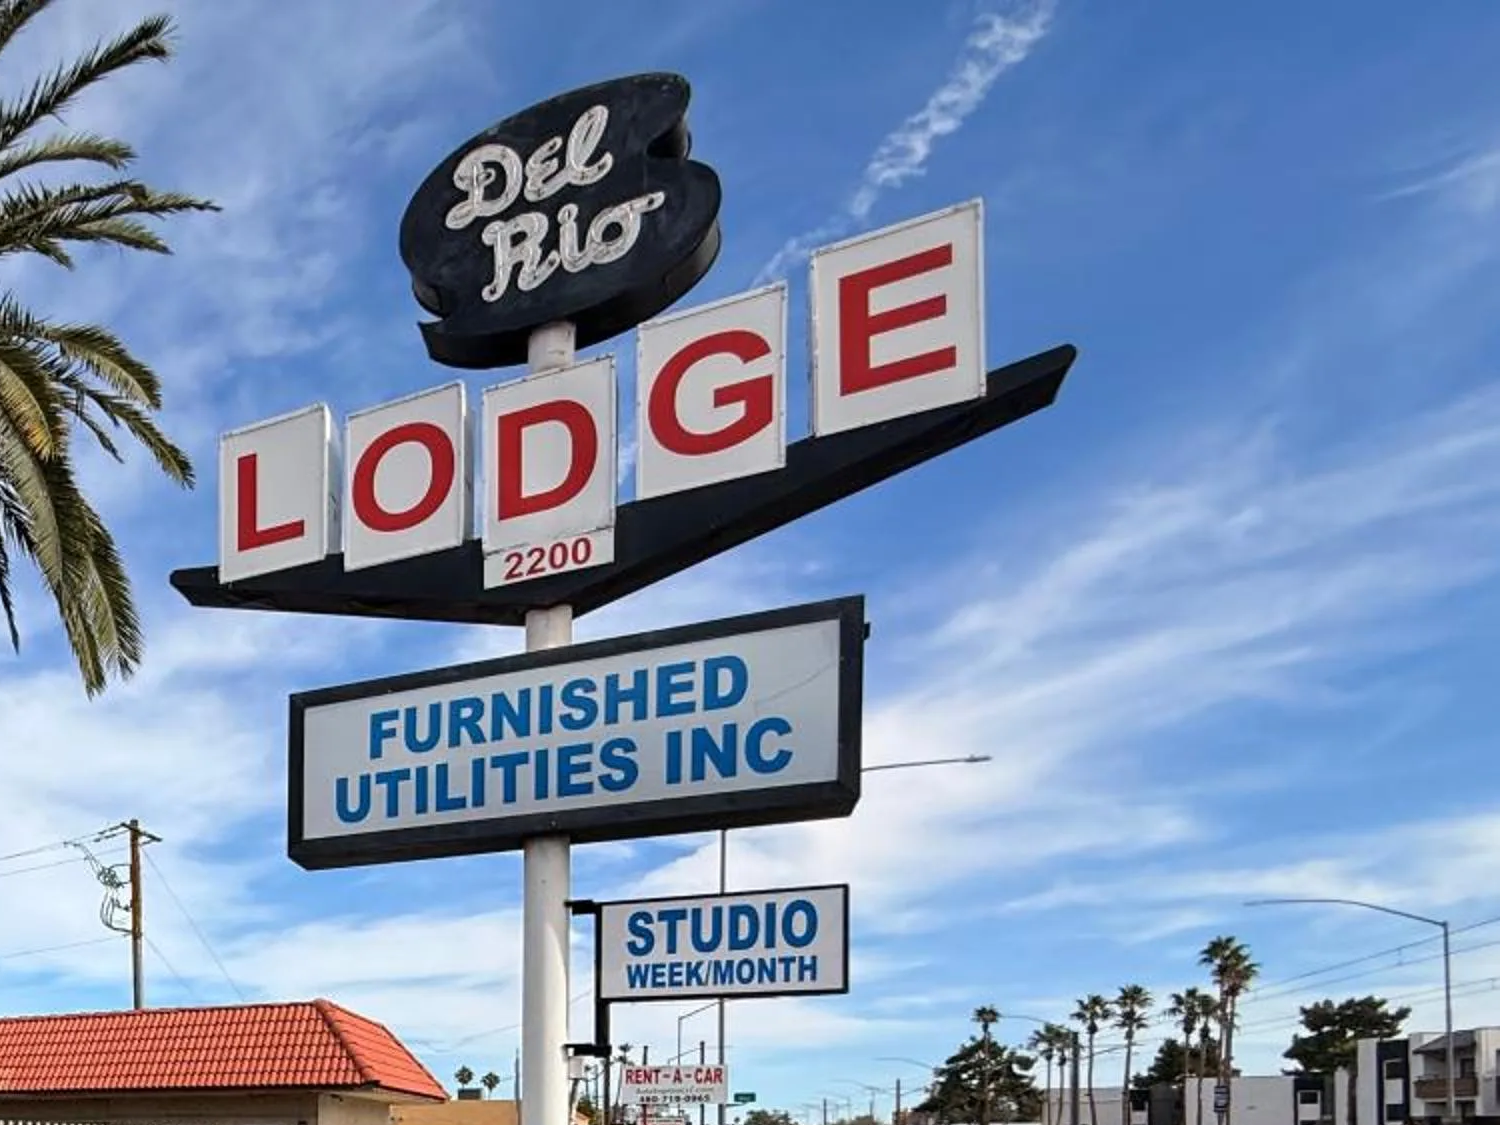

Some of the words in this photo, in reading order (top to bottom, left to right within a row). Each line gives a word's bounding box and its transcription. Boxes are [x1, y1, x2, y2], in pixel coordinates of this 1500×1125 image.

[444, 103, 615, 231] Del
[480, 190, 667, 304] Rio
[236, 244, 958, 553] LODGE
[503, 537, 592, 581] 2200
[368, 654, 750, 761] FURNISHED
[334, 736, 640, 825] UTILITIES
[664, 715, 794, 786] INC
[626, 899, 818, 957] STUDIO
[626, 955, 818, 989] WEEK/MONTH
[625, 1067, 723, 1085] RENT-A-CAR
